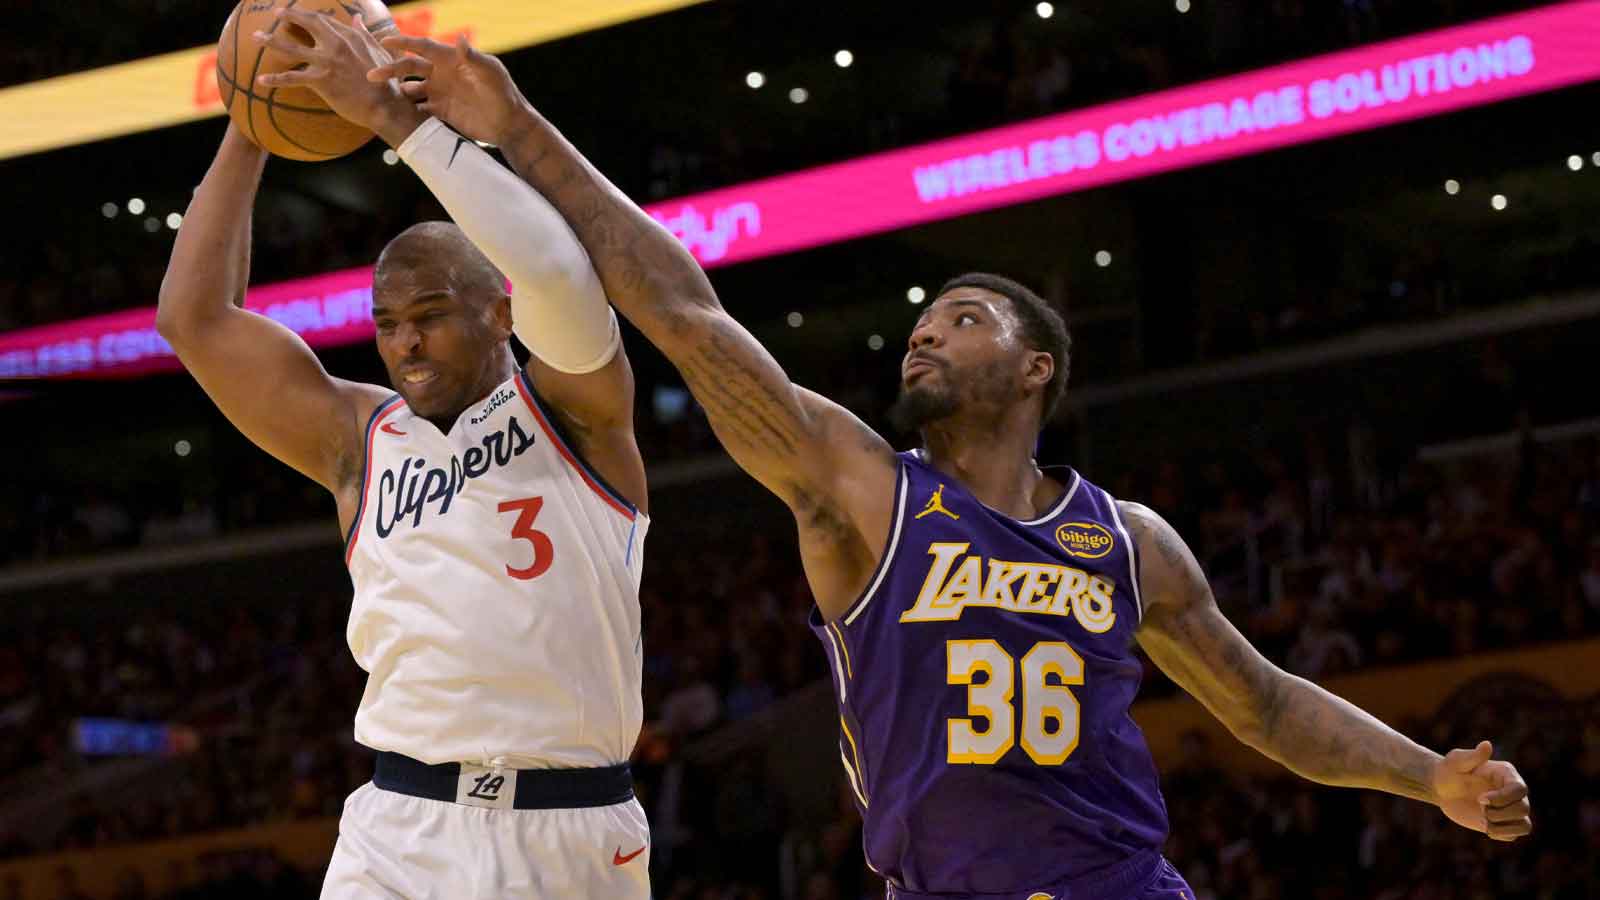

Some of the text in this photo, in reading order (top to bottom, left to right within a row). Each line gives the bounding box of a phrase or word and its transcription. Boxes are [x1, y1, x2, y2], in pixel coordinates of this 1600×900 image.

[911, 35, 1534, 203] WIRELESS COVERAGE SOLUTIONS
[471, 390, 516, 424] RWANDA
[376, 416, 535, 539] Clippers
[497, 496, 554, 580] 3
[1061, 530, 1109, 548] bibigo
[946, 639, 1085, 766] 36
[467, 772, 505, 800] LA
